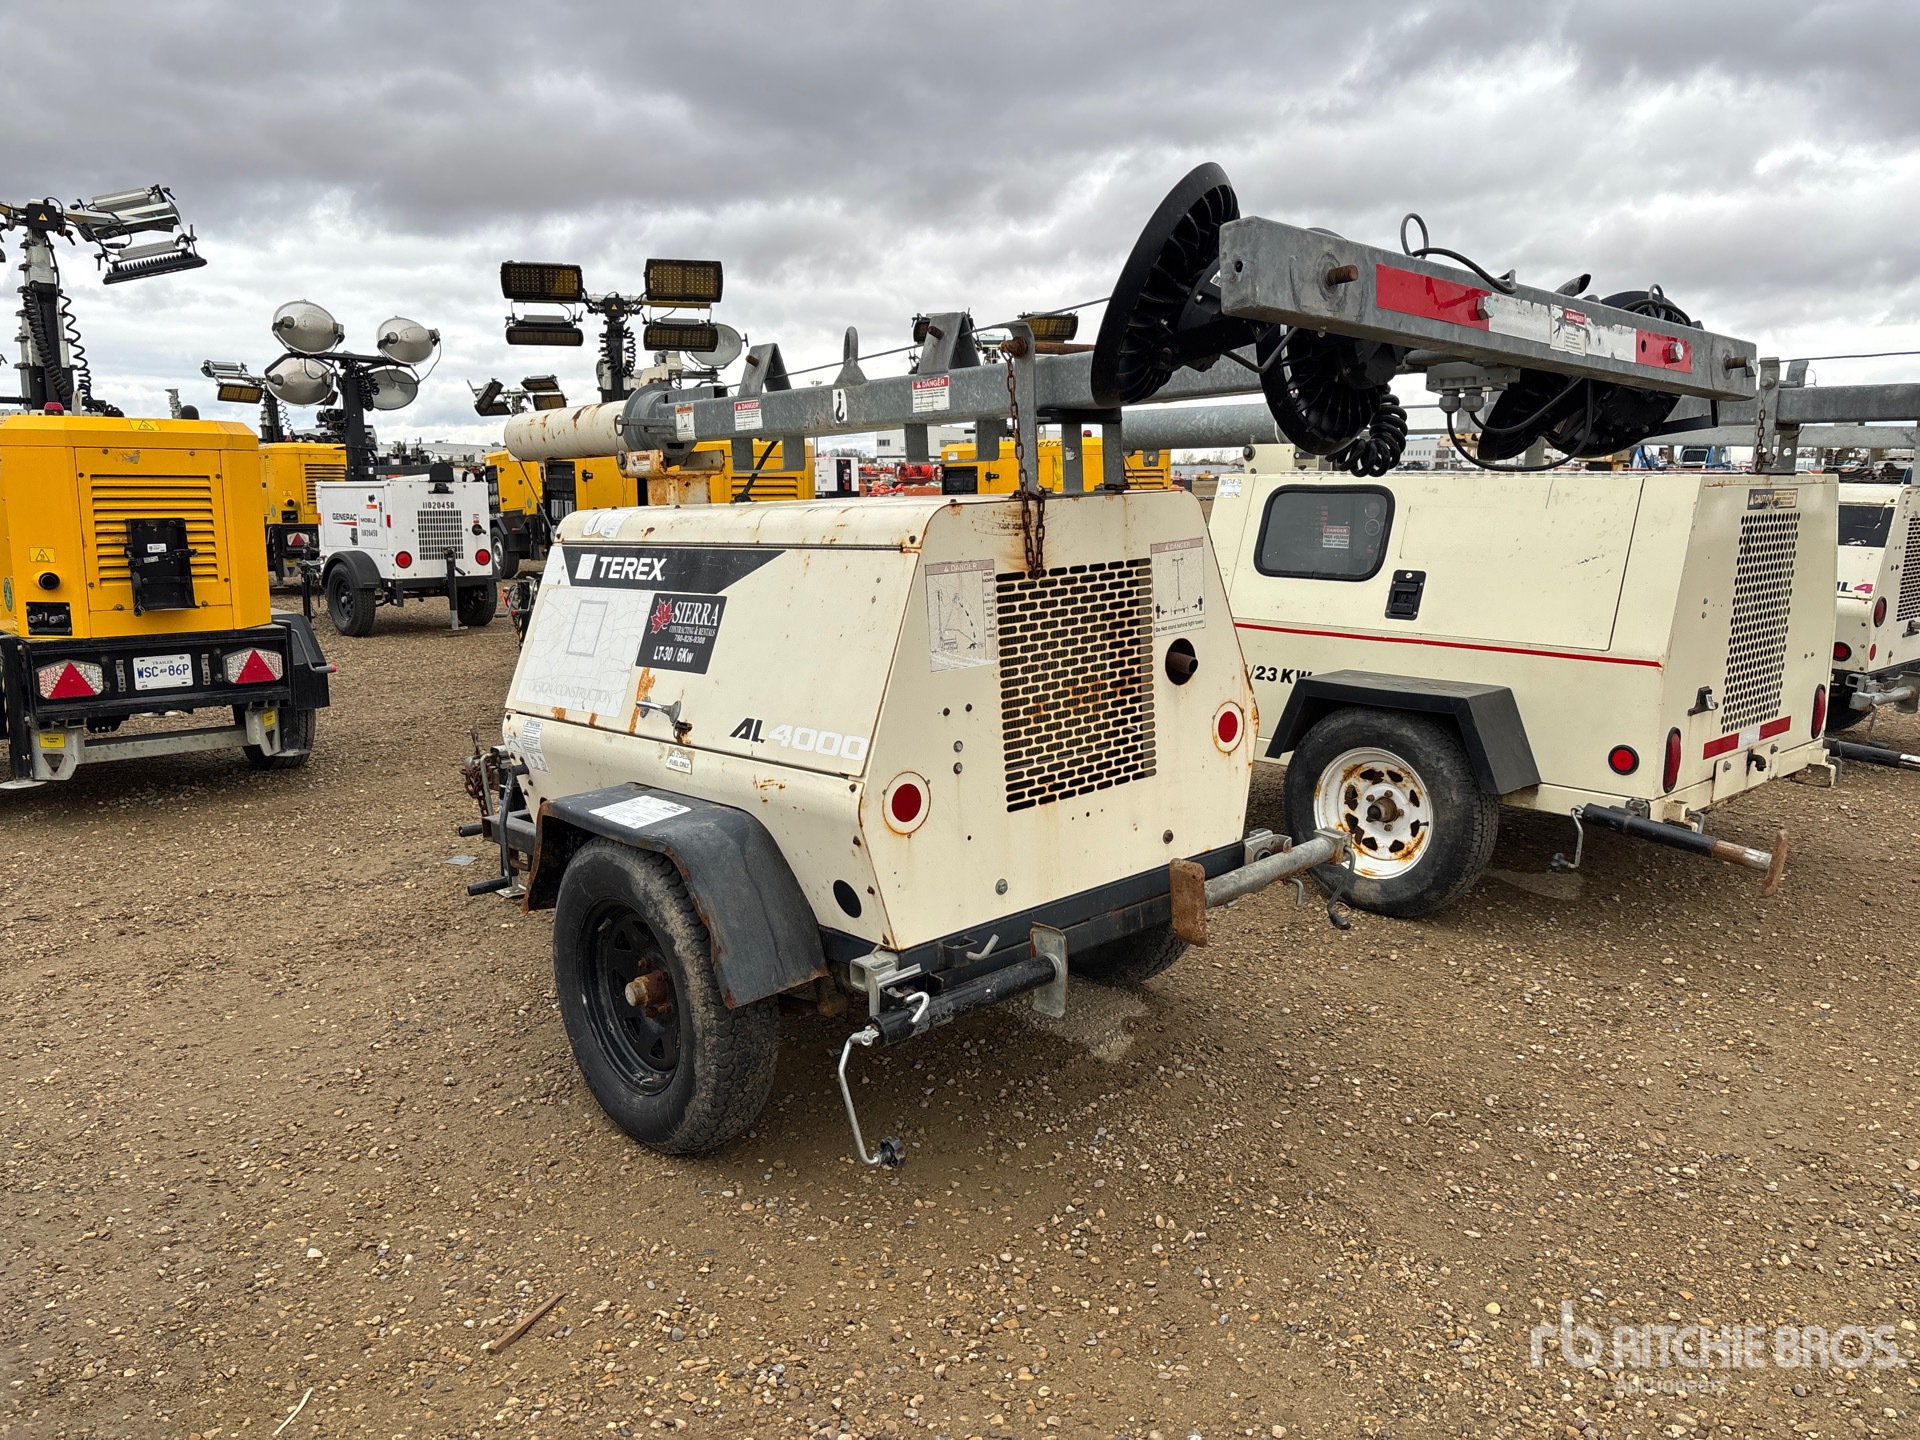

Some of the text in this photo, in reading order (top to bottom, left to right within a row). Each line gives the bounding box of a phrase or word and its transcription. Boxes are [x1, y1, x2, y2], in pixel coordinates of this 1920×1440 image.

[921, 378, 945, 388] DANGER
[741, 402, 760, 410] DANGER
[422, 501, 455, 509] 11020458
[332, 512, 357, 521] GENERAC
[599, 556, 668, 581] TEREX
[950, 562, 978, 571] DANGER
[671, 601, 720, 626] SIERRA
[653, 646, 674, 661] LT-30
[137, 663, 190, 678] WSC 86P
[768, 724, 869, 761] 4000
